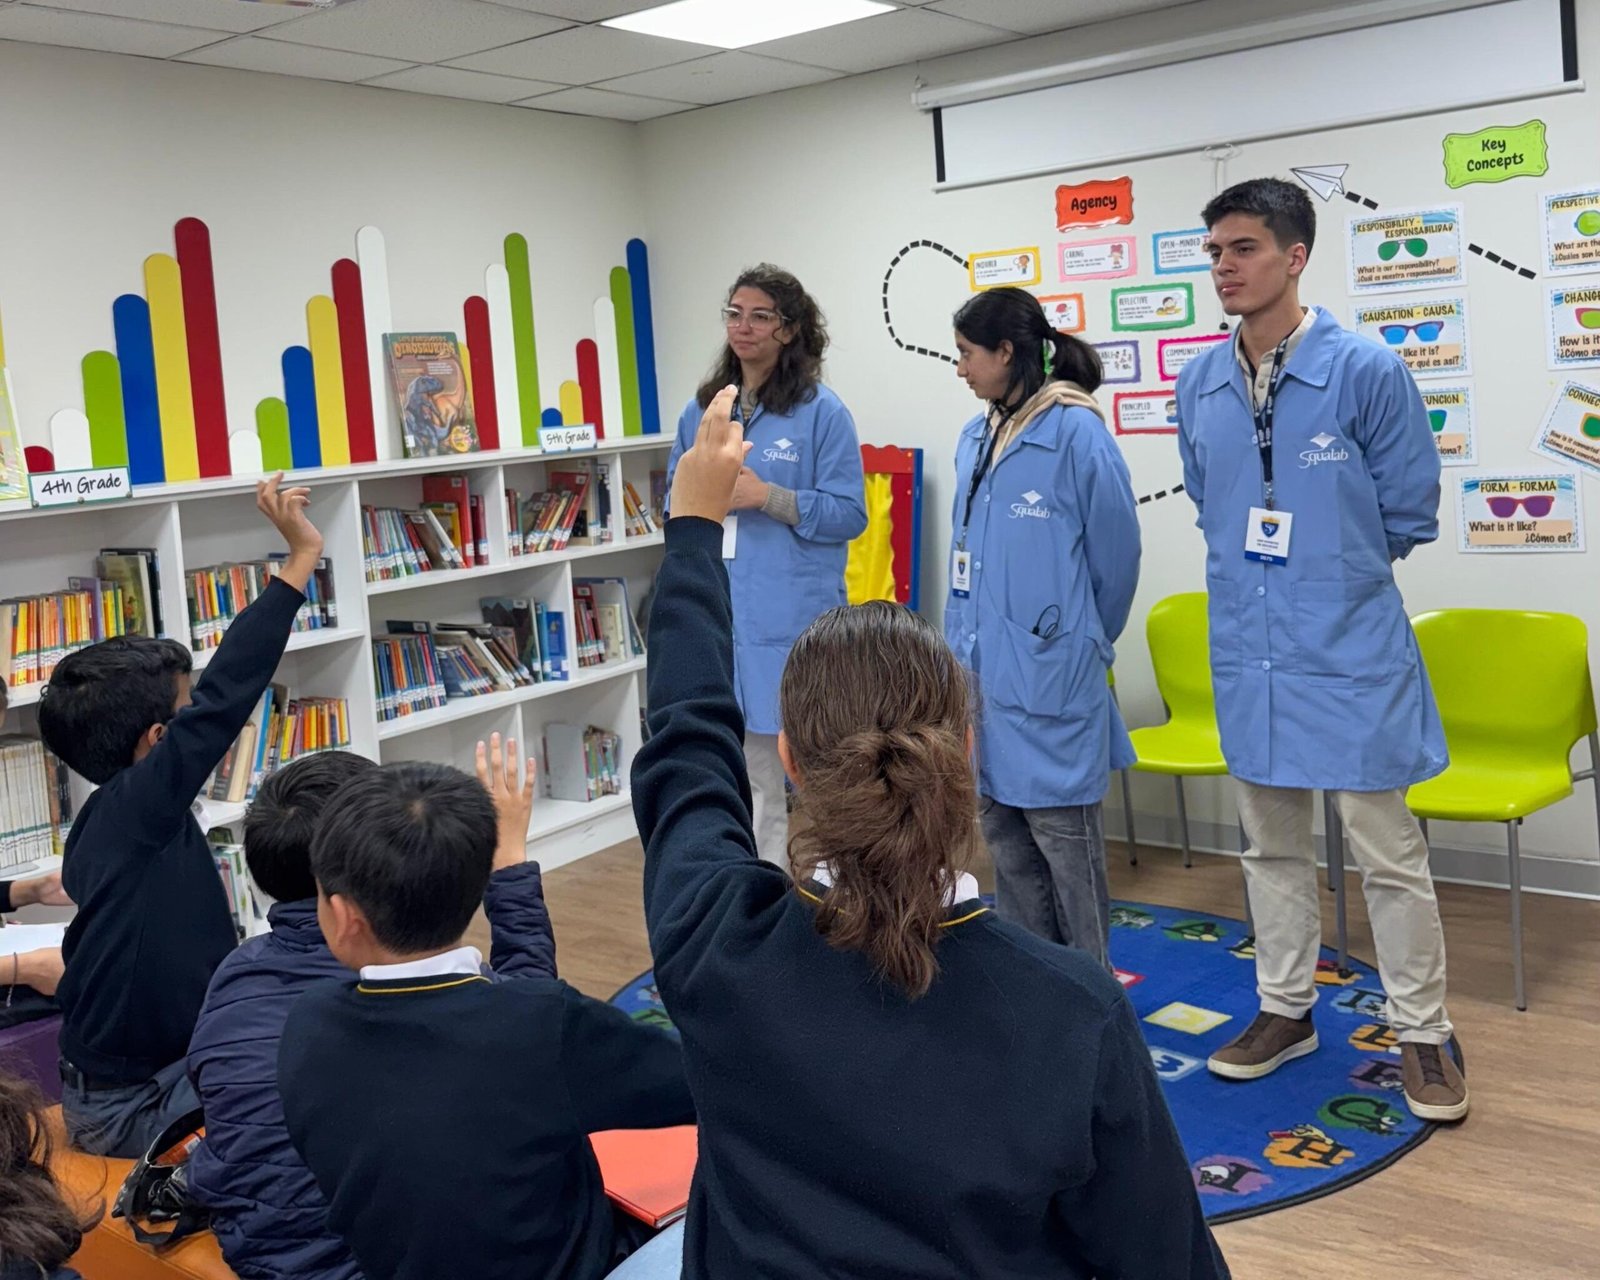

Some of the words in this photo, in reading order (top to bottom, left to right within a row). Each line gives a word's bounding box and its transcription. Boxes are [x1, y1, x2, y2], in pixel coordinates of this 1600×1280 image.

[1481, 139, 1506, 153] Key
[1466, 153, 1524, 172] Concepts
[1071, 195, 1117, 215] Agency
[1552, 195, 1599, 209] PERSPECTIVE
[1357, 218, 1415, 233] RESPONSIBILITY
[1385, 223, 1454, 239] RESPONSABILIDAD
[1554, 242, 1574, 251] What
[1357, 265, 1375, 274] What
[1377, 264, 1382, 273] is
[1395, 259, 1440, 270] responsibility?
[1362, 308, 1414, 322] CAUSATION
[1423, 304, 1455, 317] CAUSA
[1559, 336, 1580, 347] How
[1583, 335, 1590, 345] is
[1403, 348, 1418, 358] like
[1420, 346, 1426, 356] it
[1428, 345, 1440, 355] is?
[1560, 348, 1589, 358] ¿Cómo
[1416, 358, 1431, 369] qué
[546, 432, 563, 445] 5th
[565, 429, 591, 444] Grade
[761, 448, 800, 463] Squalab
[1298, 448, 1349, 469] Squalab
[41, 478, 73, 495] 4th
[77, 473, 122, 494] Grade
[1480, 482, 1509, 493] FORM
[1520, 480, 1557, 492] FORMA
[1007, 503, 1051, 519] Squalab
[1469, 521, 1495, 532] What
[1497, 521, 1505, 531] is
[1507, 521, 1514, 531] it
[1516, 521, 1537, 531] like?
[1525, 533, 1555, 543] ¿Cómo
[1557, 532, 1572, 543] es?
